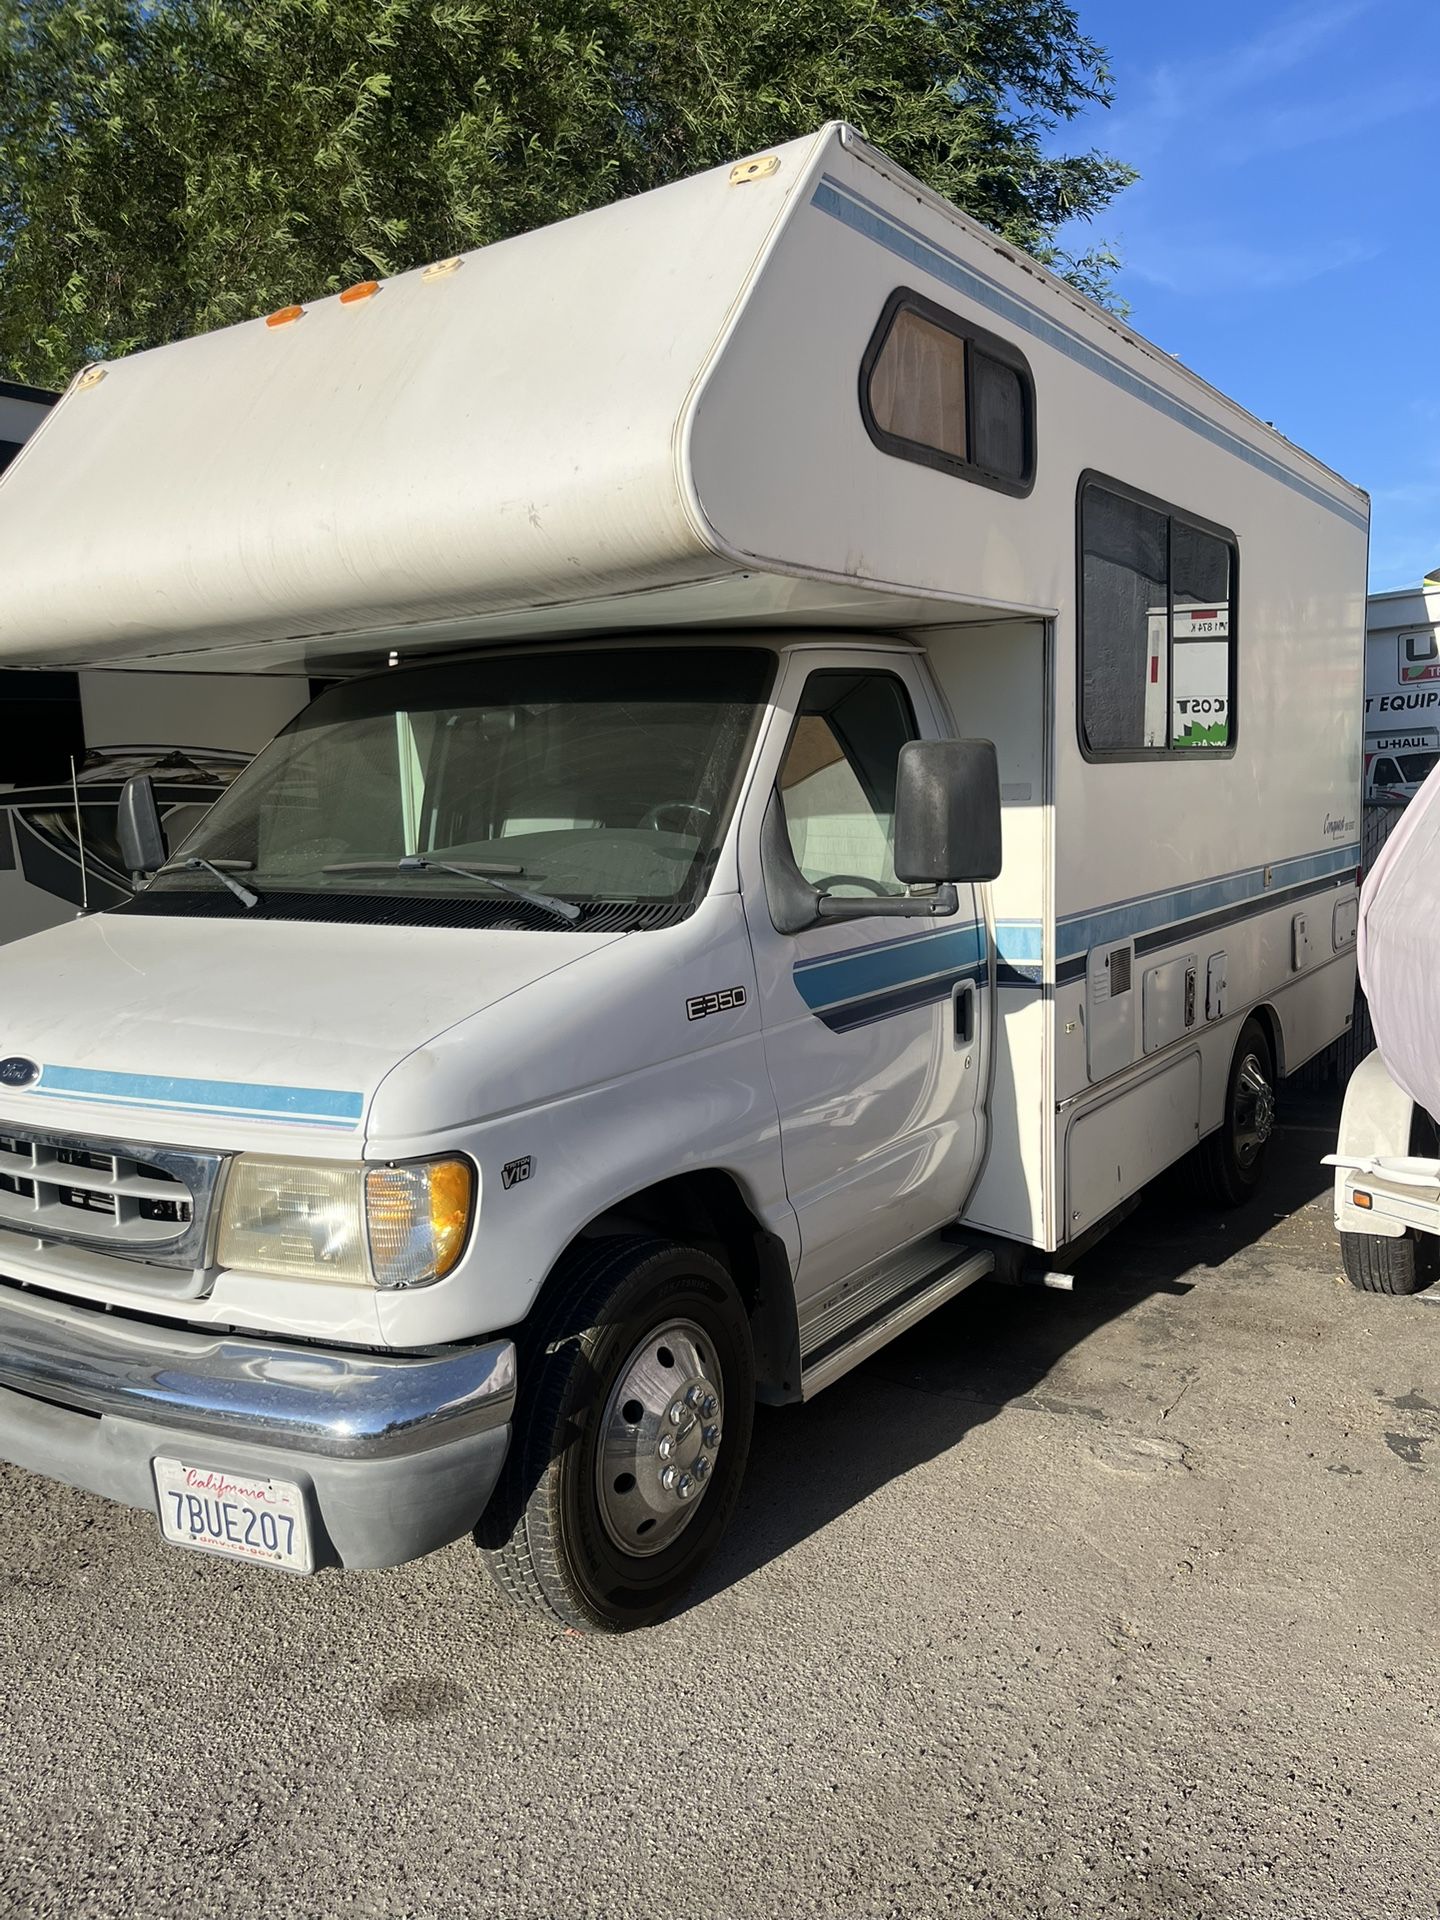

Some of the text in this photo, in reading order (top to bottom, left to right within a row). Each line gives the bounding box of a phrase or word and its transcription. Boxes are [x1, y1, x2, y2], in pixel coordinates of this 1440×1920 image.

[1379, 692, 1440, 713] EQUIP
[1377, 737, 1429, 750] U-HAUL
[501, 1163, 530, 1190] V10
[186, 1469, 275, 1503] California
[168, 1490, 294, 1556] 7BUE207
[200, 1536, 273, 1558] dmv.ca.gov
